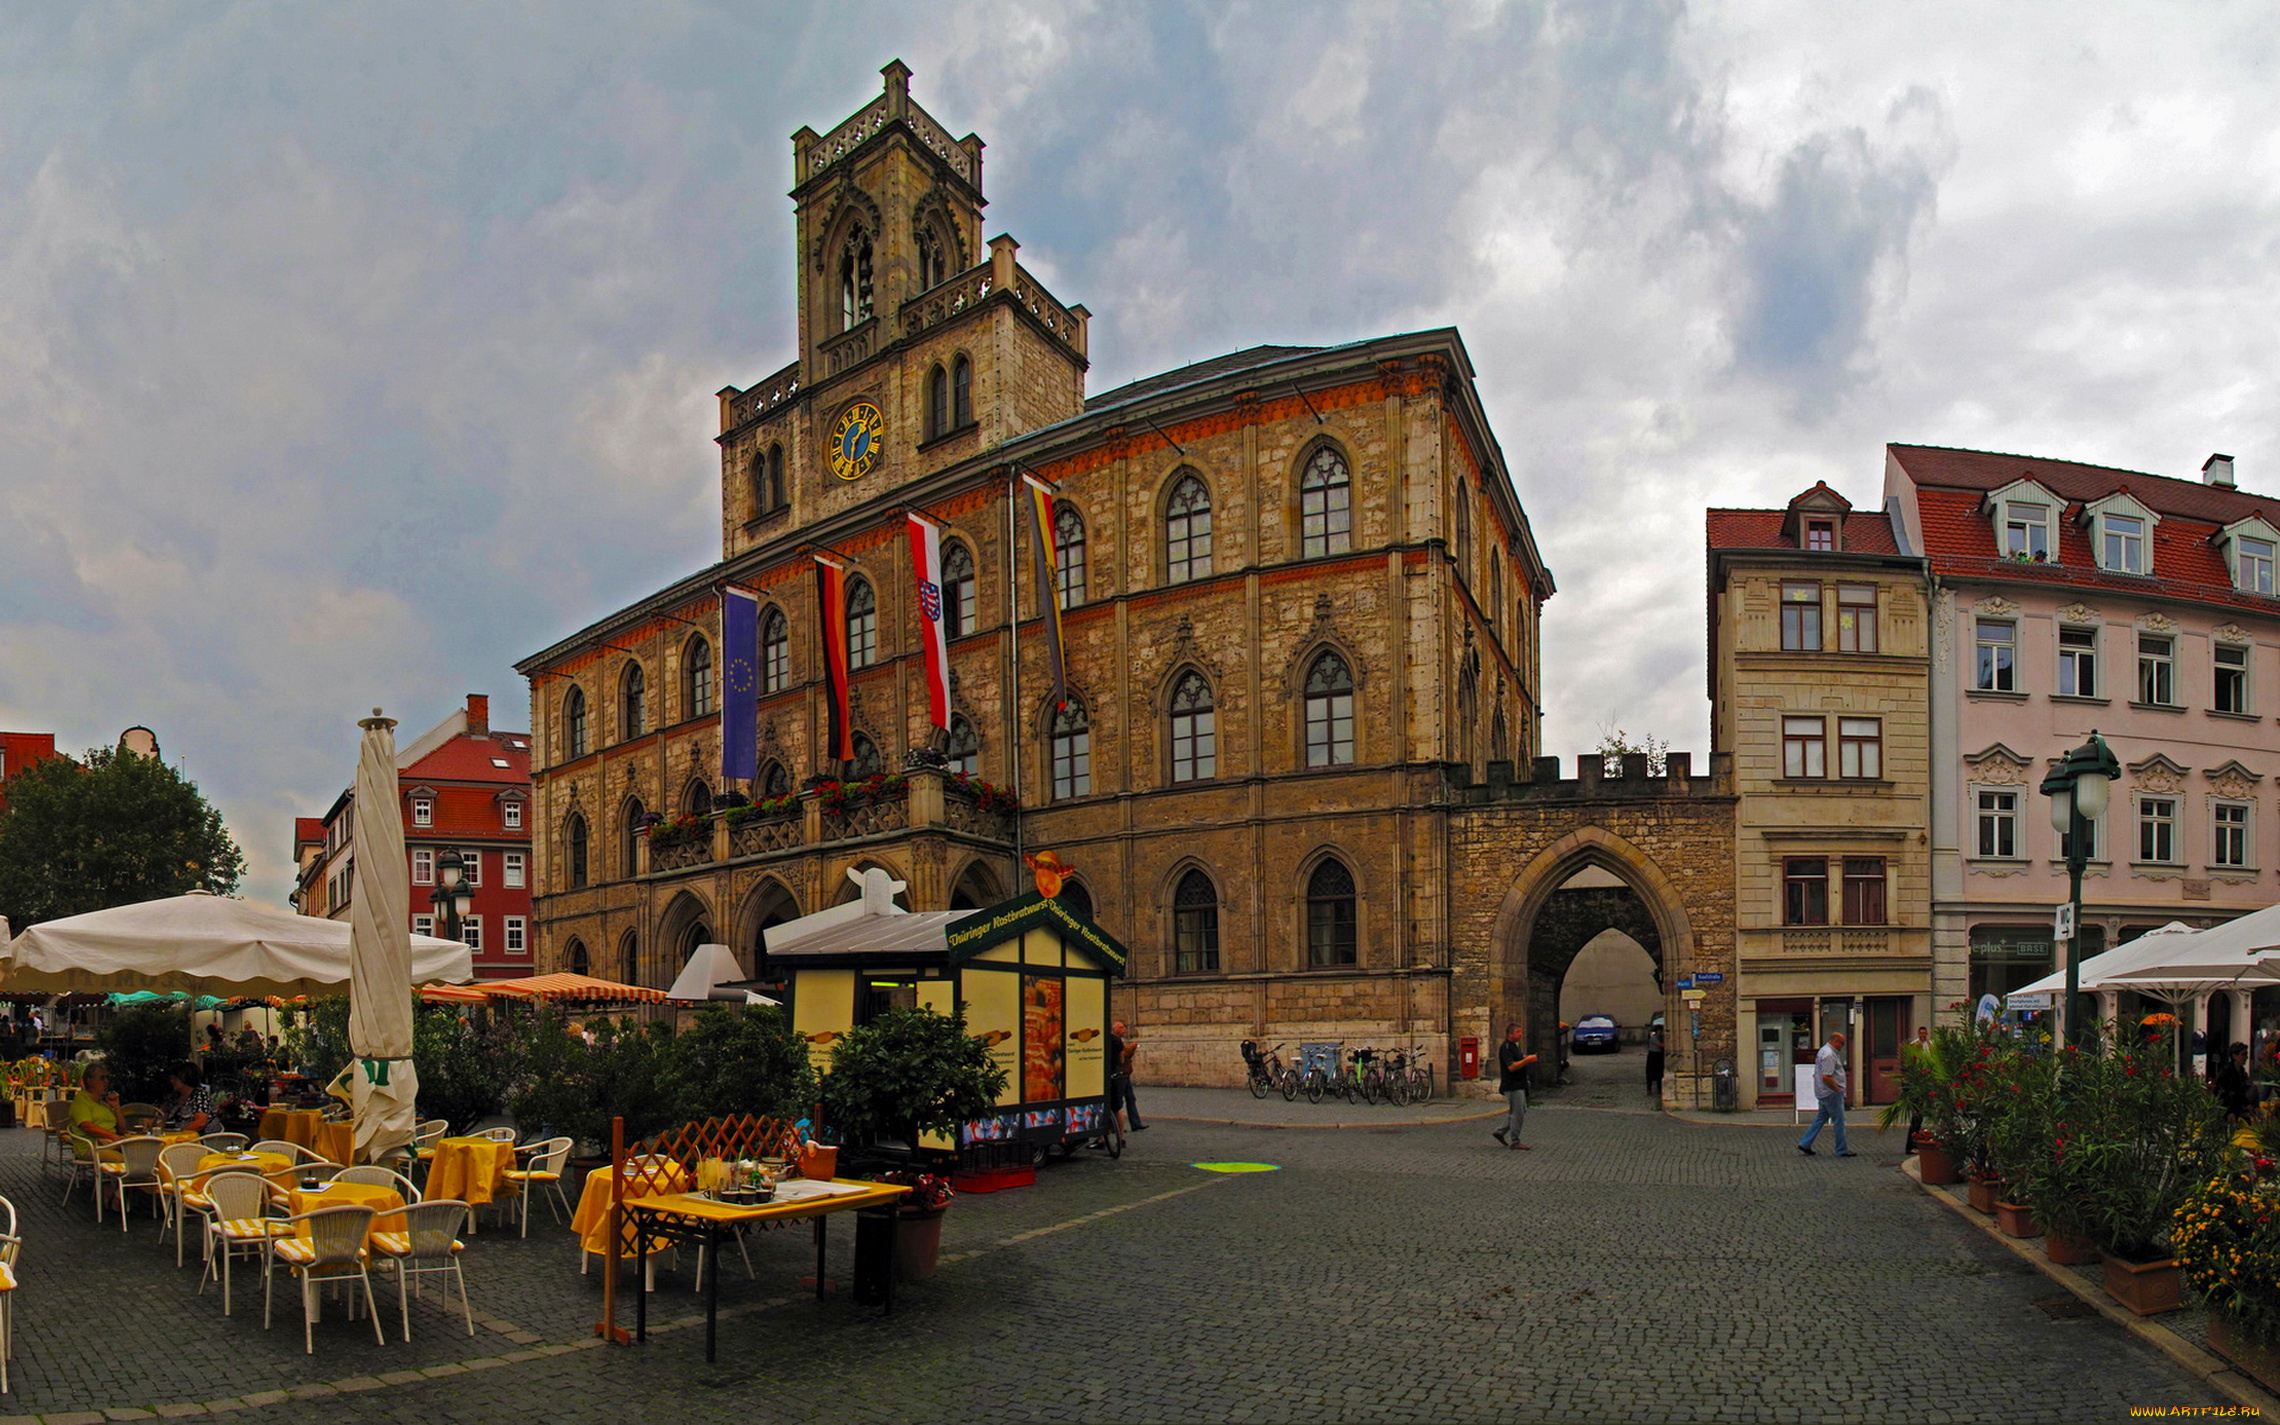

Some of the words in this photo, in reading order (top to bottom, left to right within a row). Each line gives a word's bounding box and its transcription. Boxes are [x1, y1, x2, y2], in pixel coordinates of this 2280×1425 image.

[948, 921, 991, 947] Thüringer
[992, 898, 1049, 930] Rostbratwurst
[1048, 899, 1081, 931] Thüringer
[2059, 906, 2072, 926] WC
[2019, 944, 2046, 953] BASE
